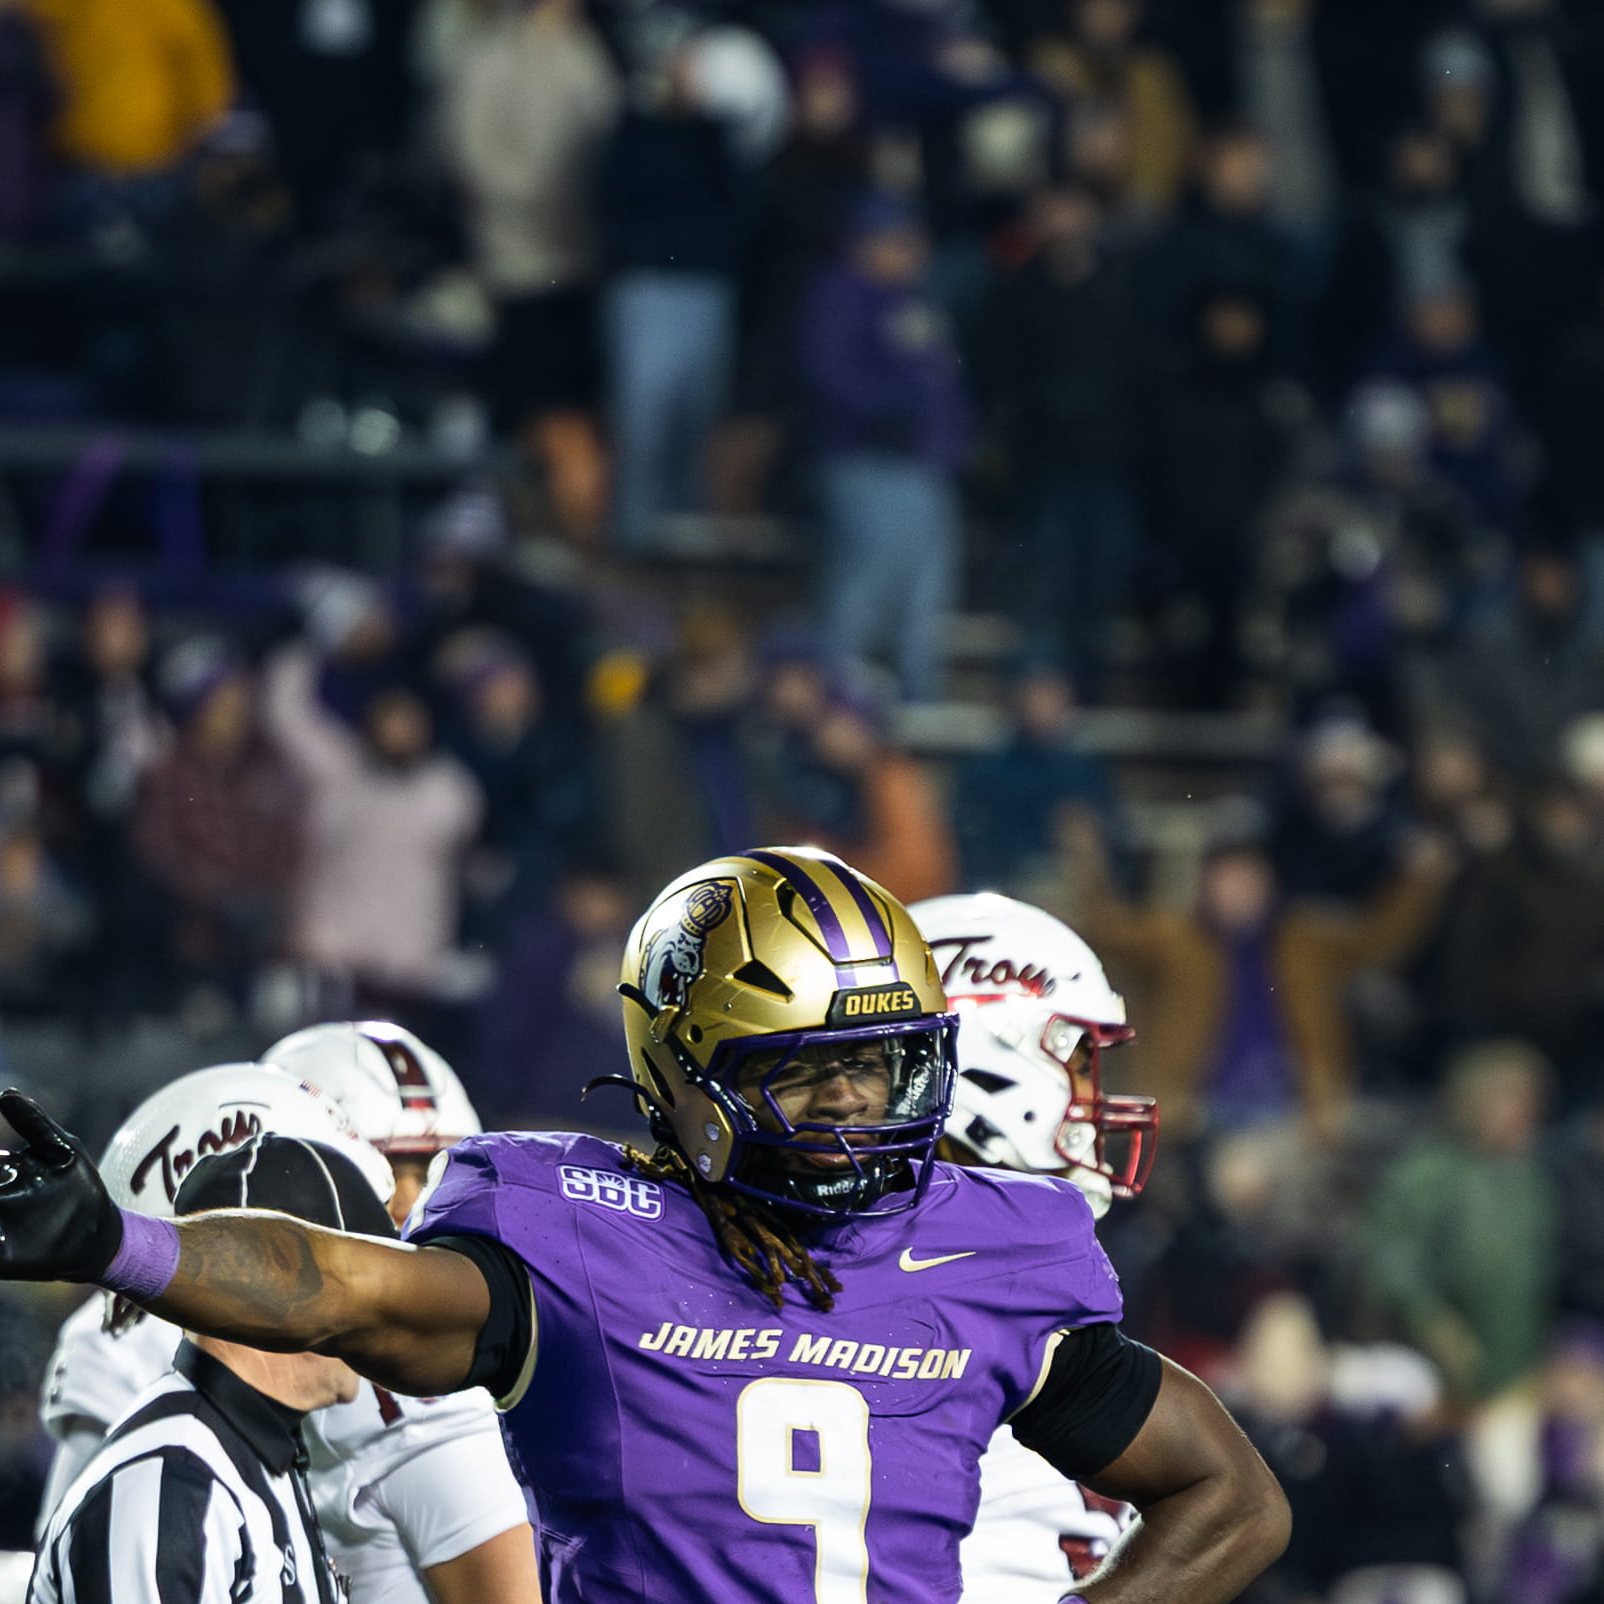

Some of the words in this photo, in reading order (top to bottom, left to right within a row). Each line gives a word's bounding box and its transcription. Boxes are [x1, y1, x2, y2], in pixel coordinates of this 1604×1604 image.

[846, 989, 915, 1017] DUKES
[559, 1164, 663, 1219] SBC
[638, 1321, 784, 1360] JAMES
[788, 1333, 973, 1380] MADISON
